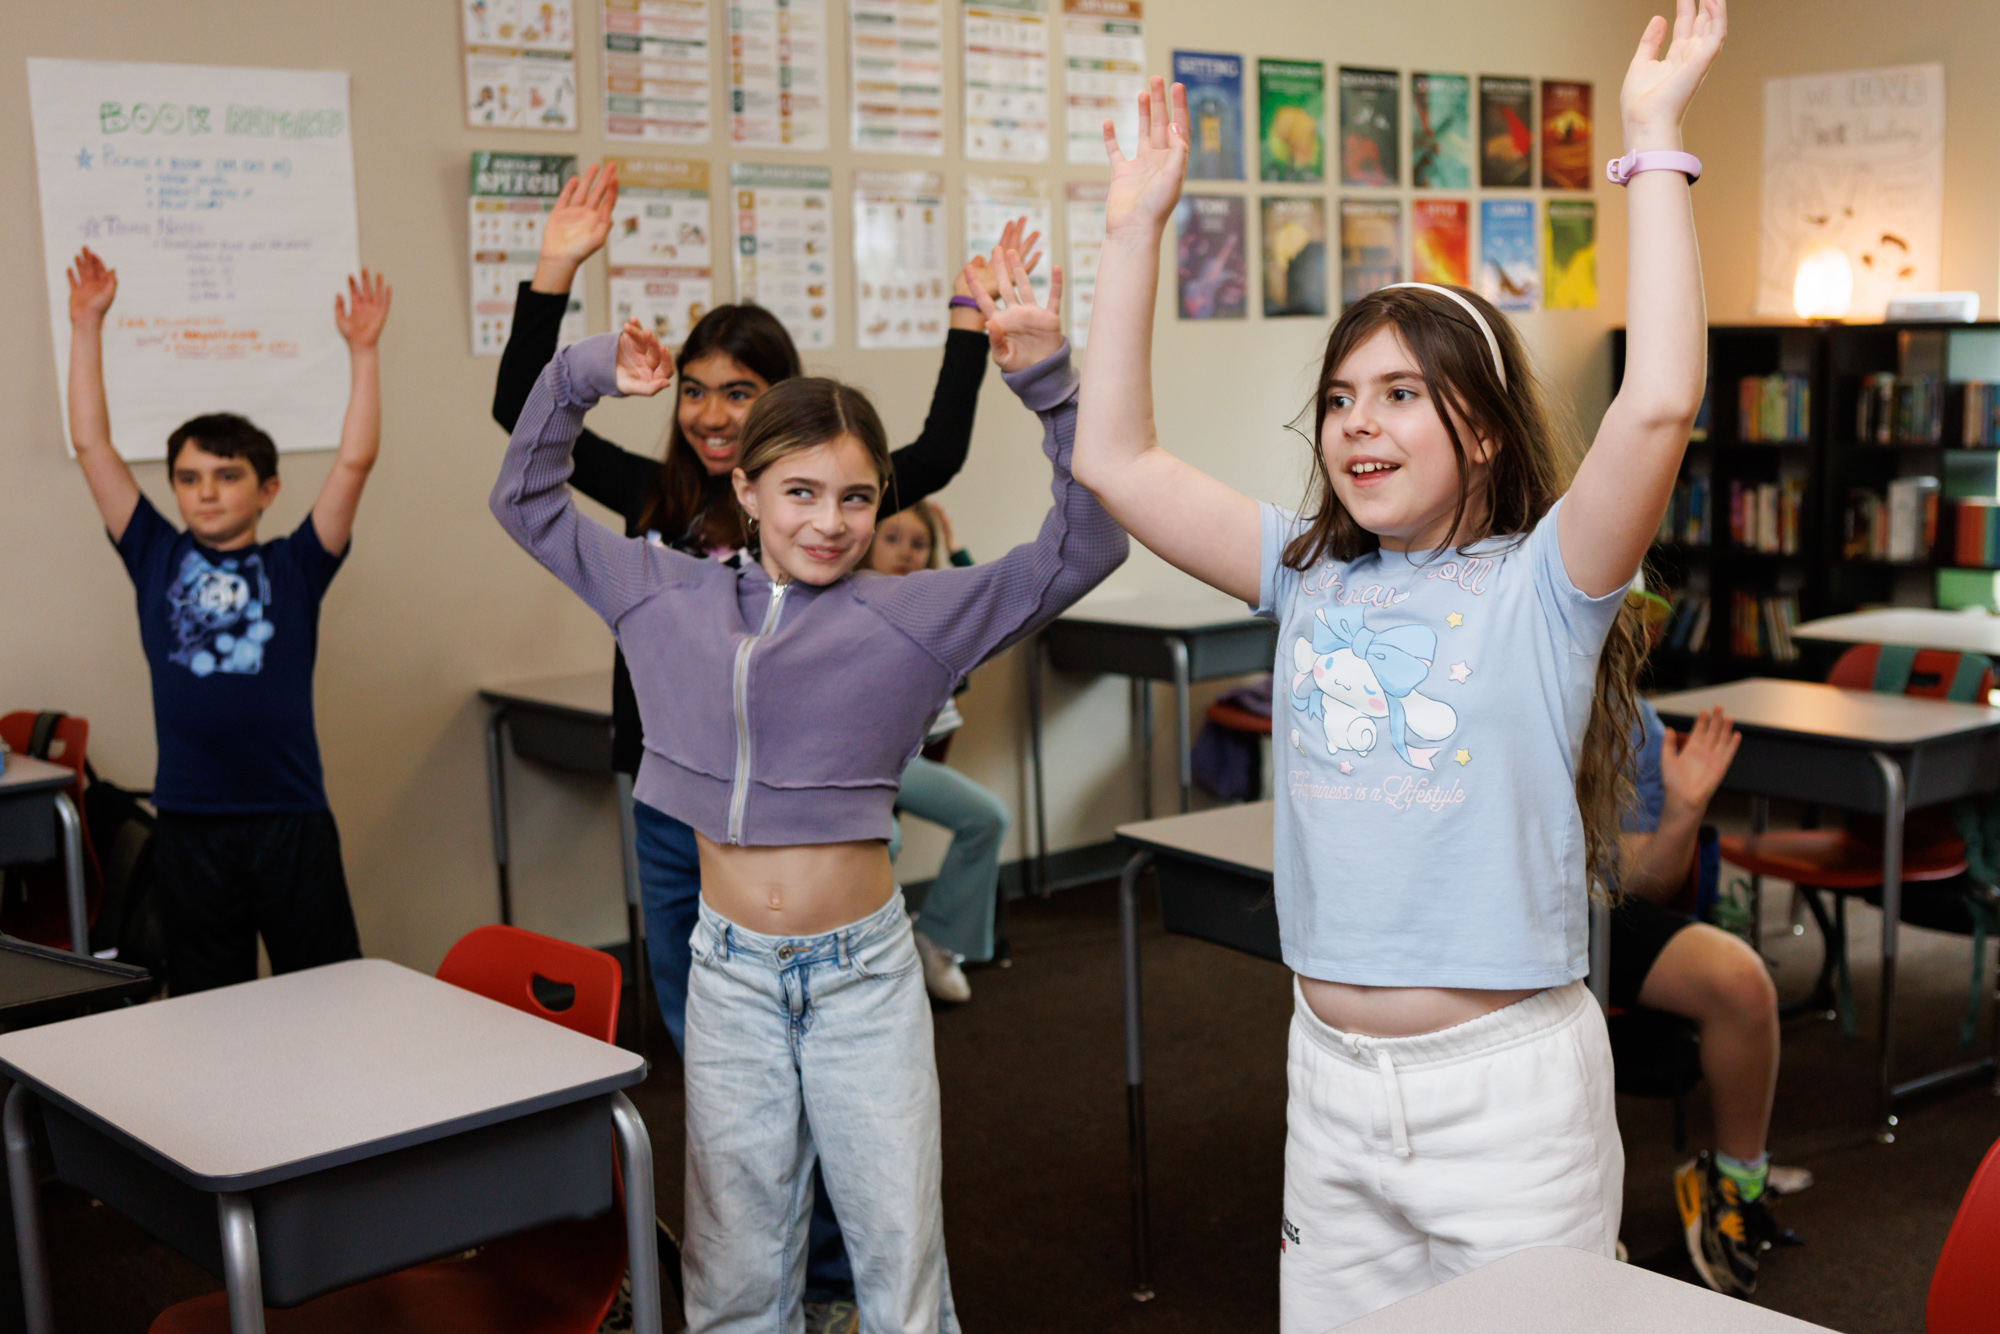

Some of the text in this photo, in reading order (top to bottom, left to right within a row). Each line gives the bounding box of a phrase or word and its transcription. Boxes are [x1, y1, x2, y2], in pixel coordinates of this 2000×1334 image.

[99, 101, 212, 136] BOOK
[1354, 782, 1368, 801] is
[1370, 788, 1382, 801] a
[1383, 775, 1466, 812] Lifestyle
